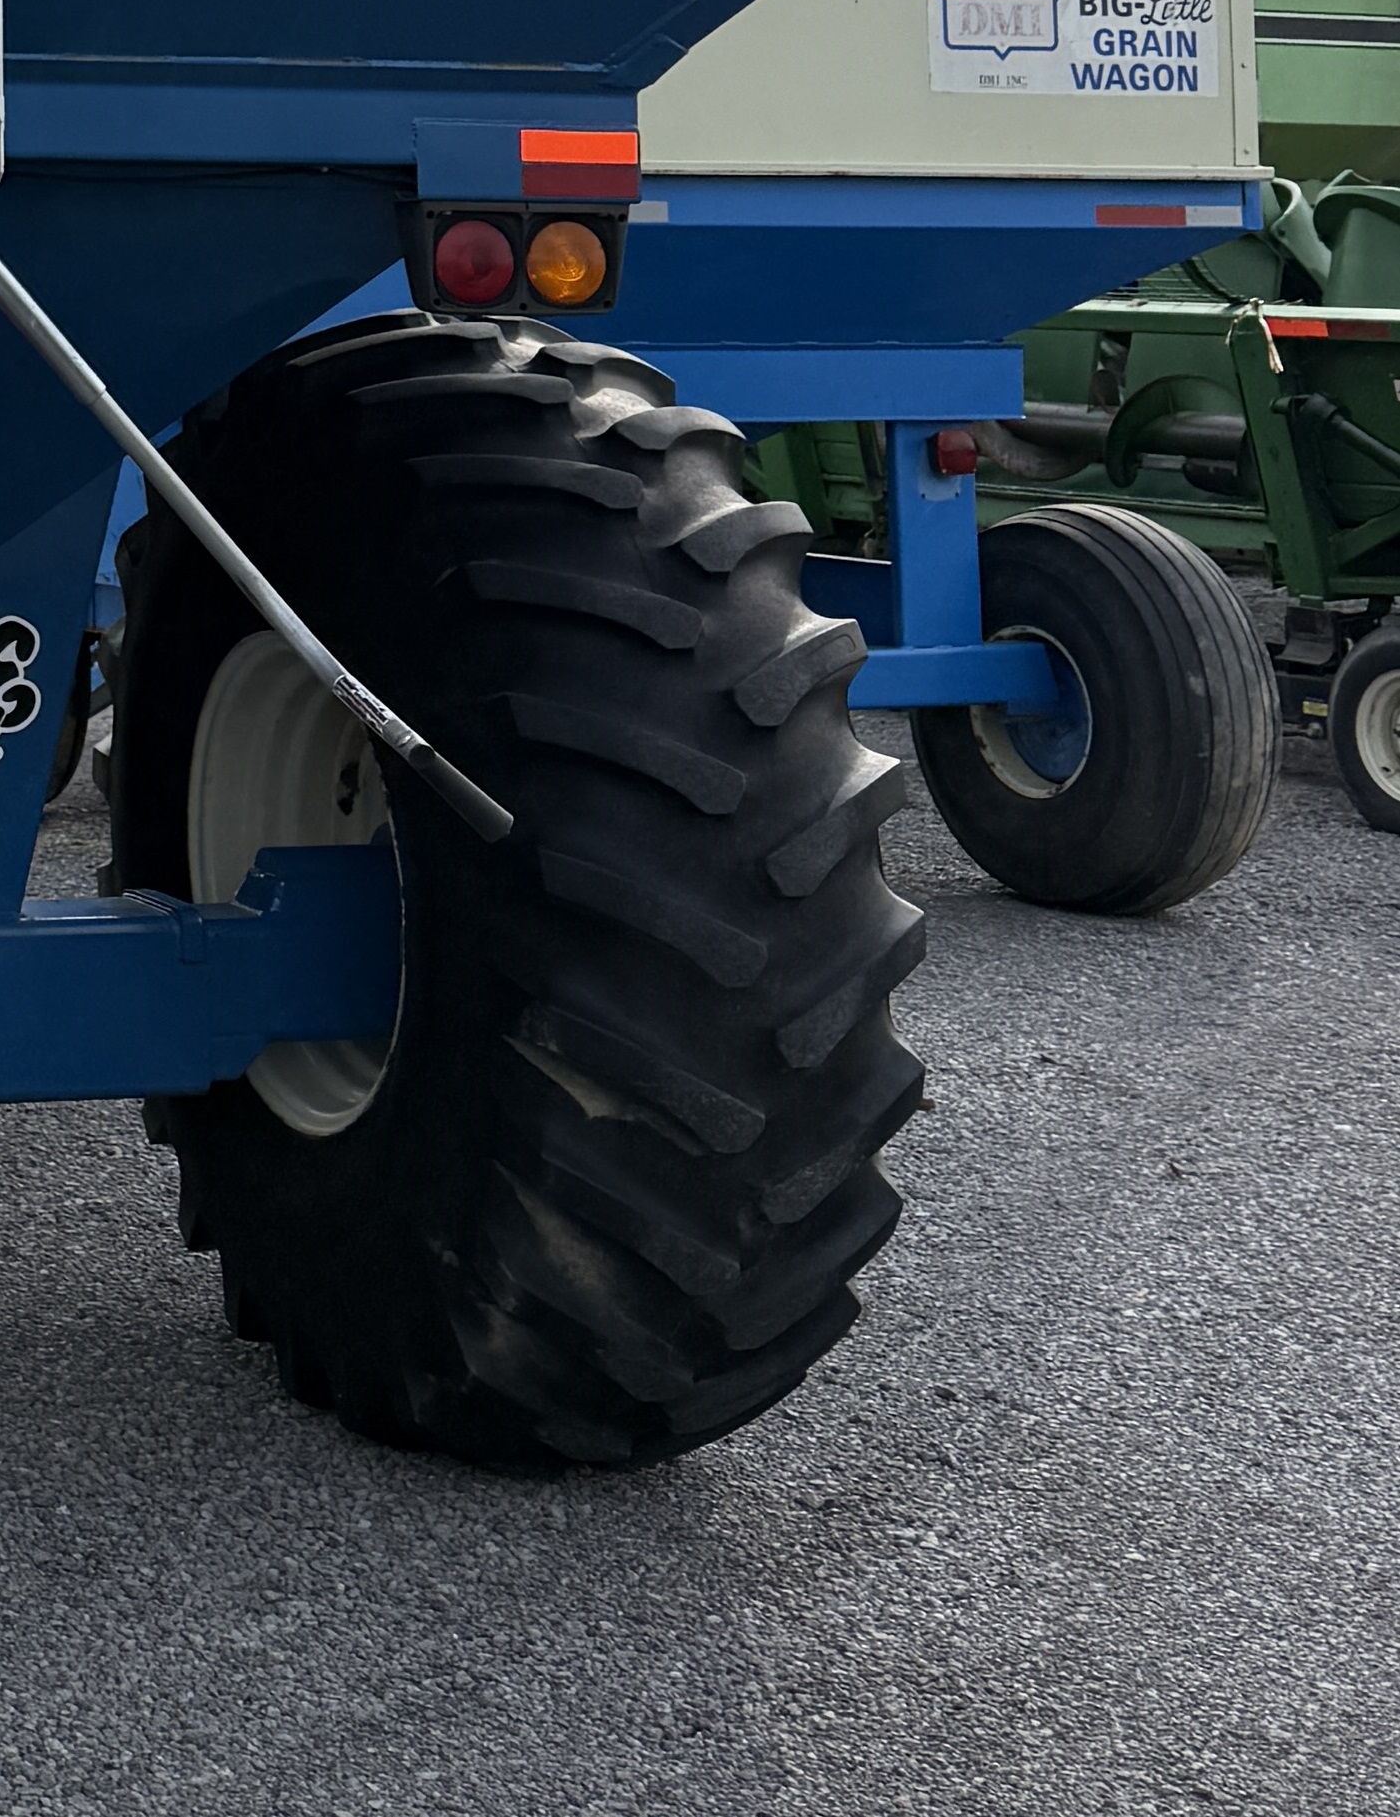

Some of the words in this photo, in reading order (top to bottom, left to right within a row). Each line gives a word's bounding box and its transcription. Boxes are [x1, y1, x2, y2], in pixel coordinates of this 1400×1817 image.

[959, 2, 1044, 36] DMI
[1093, 28, 1197, 58] GRAIN
[1071, 63, 1198, 92] WAGON
